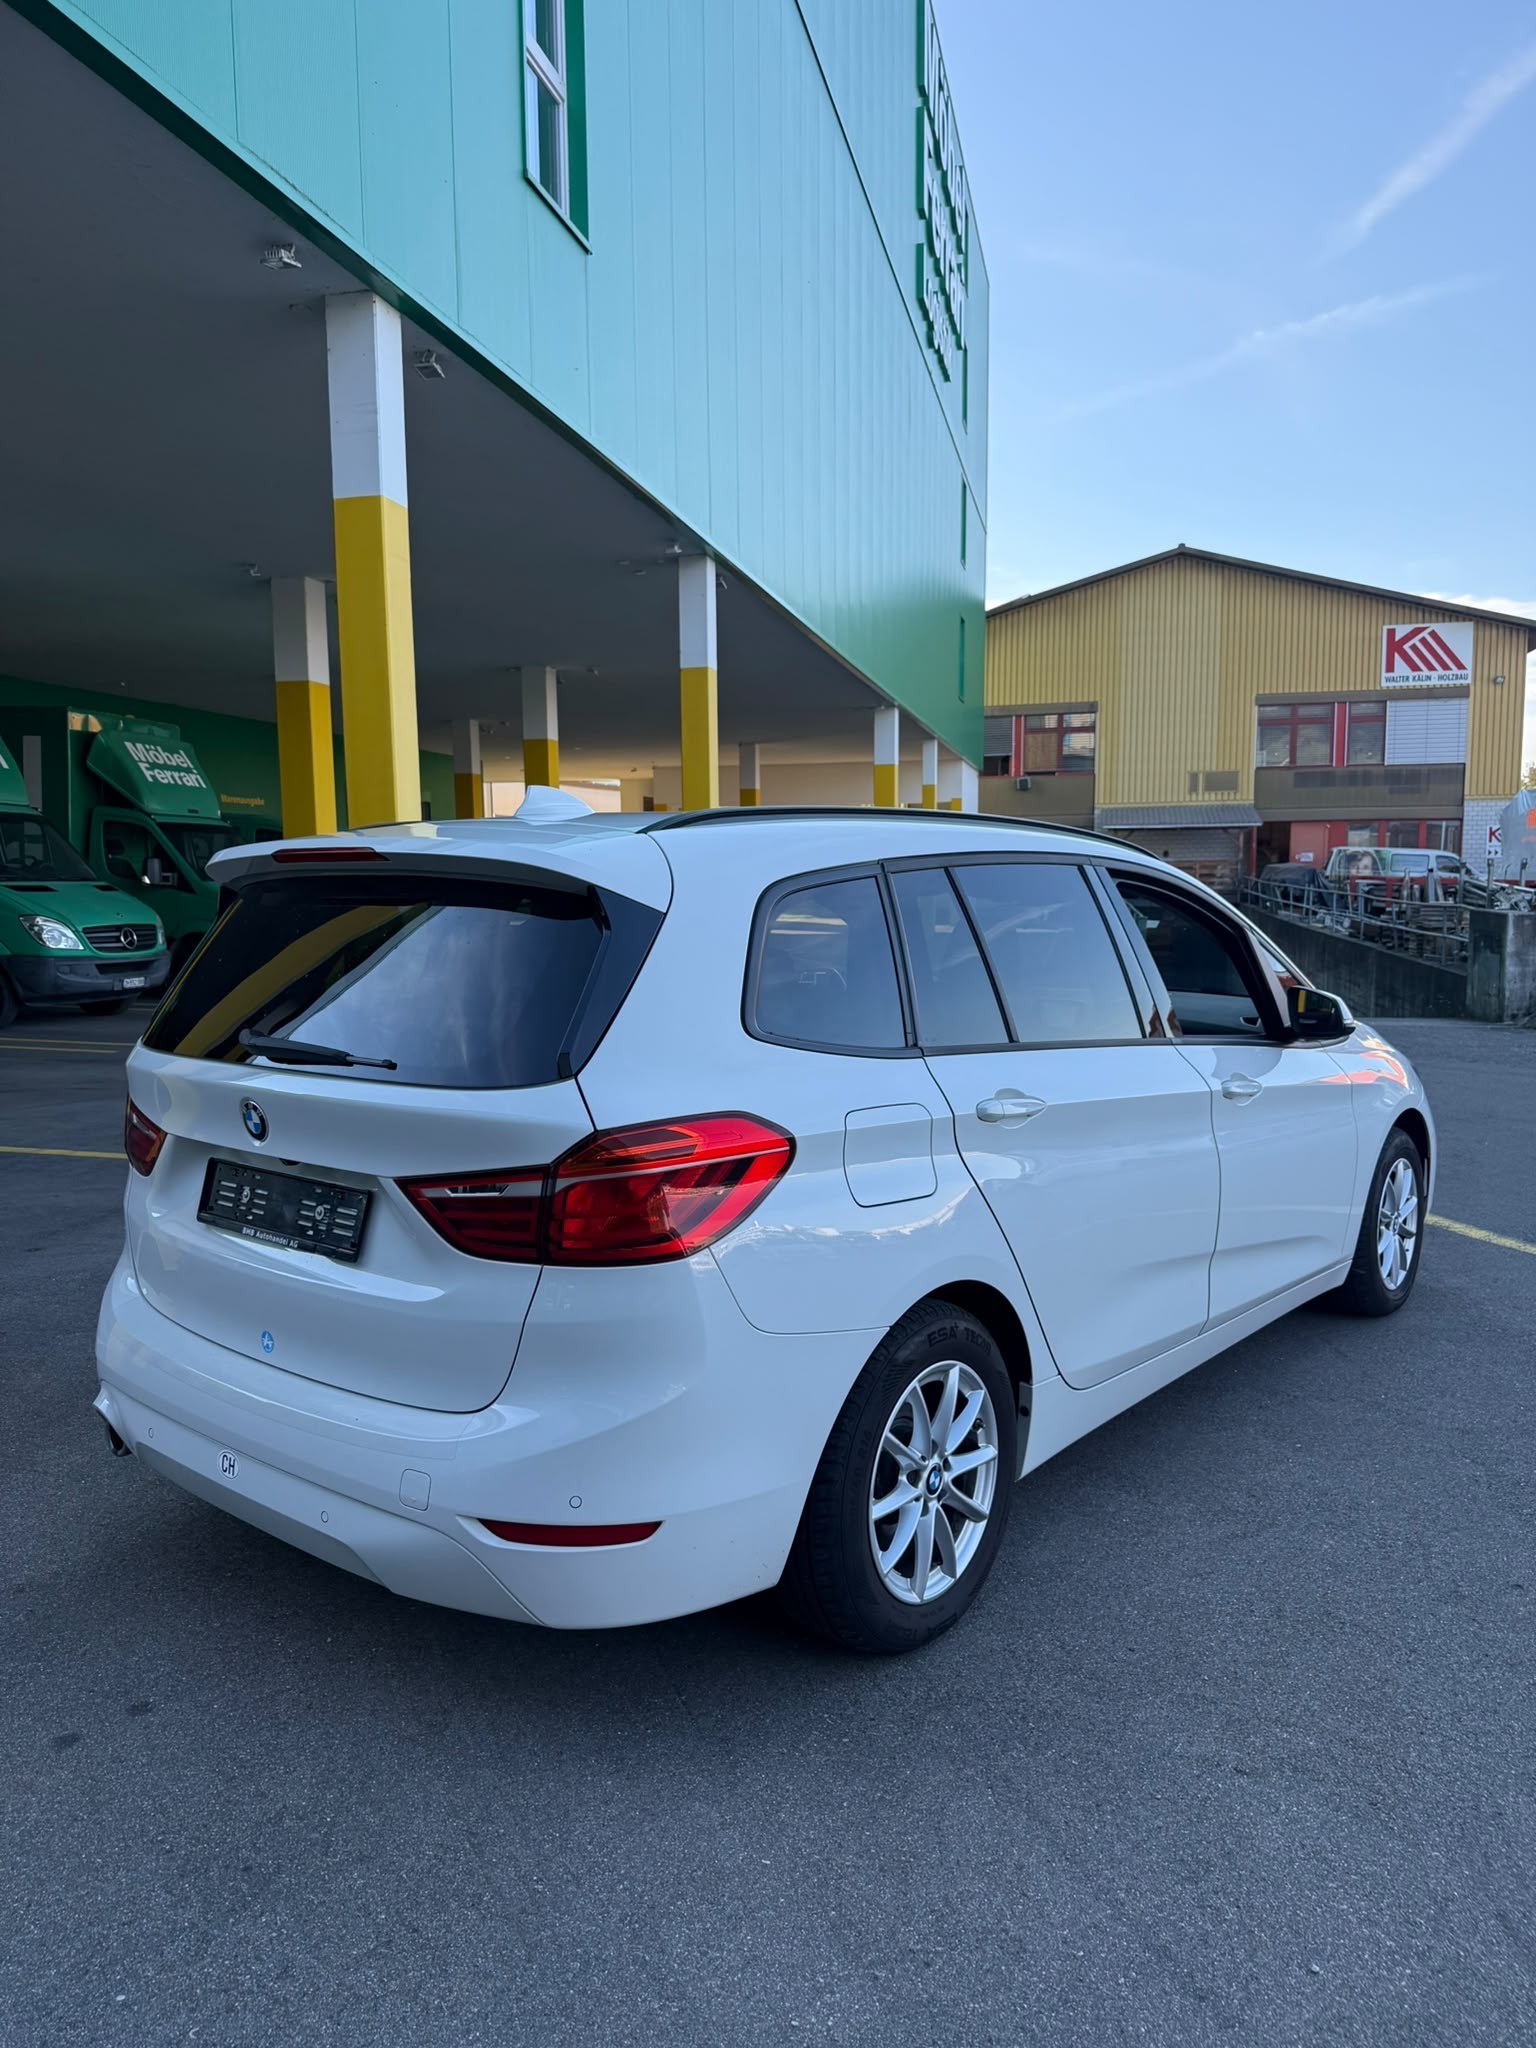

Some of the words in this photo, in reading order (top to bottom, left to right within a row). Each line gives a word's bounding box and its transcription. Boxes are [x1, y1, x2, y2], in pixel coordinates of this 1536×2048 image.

[924, 0, 966, 256] Möbel
[924, 106, 967, 351] Ferrari
[1385, 675, 1410, 684] WALTER
[1412, 673, 1432, 683] KÄLIN
[1437, 673, 1469, 682] HOLZBAU
[124, 741, 194, 769] Möbel
[137, 762, 207, 789] Ferrari
[256, 1231, 289, 1246] Autohandel
[289, 1240, 299, 1248] AG
[221, 1454, 236, 1476] CH
